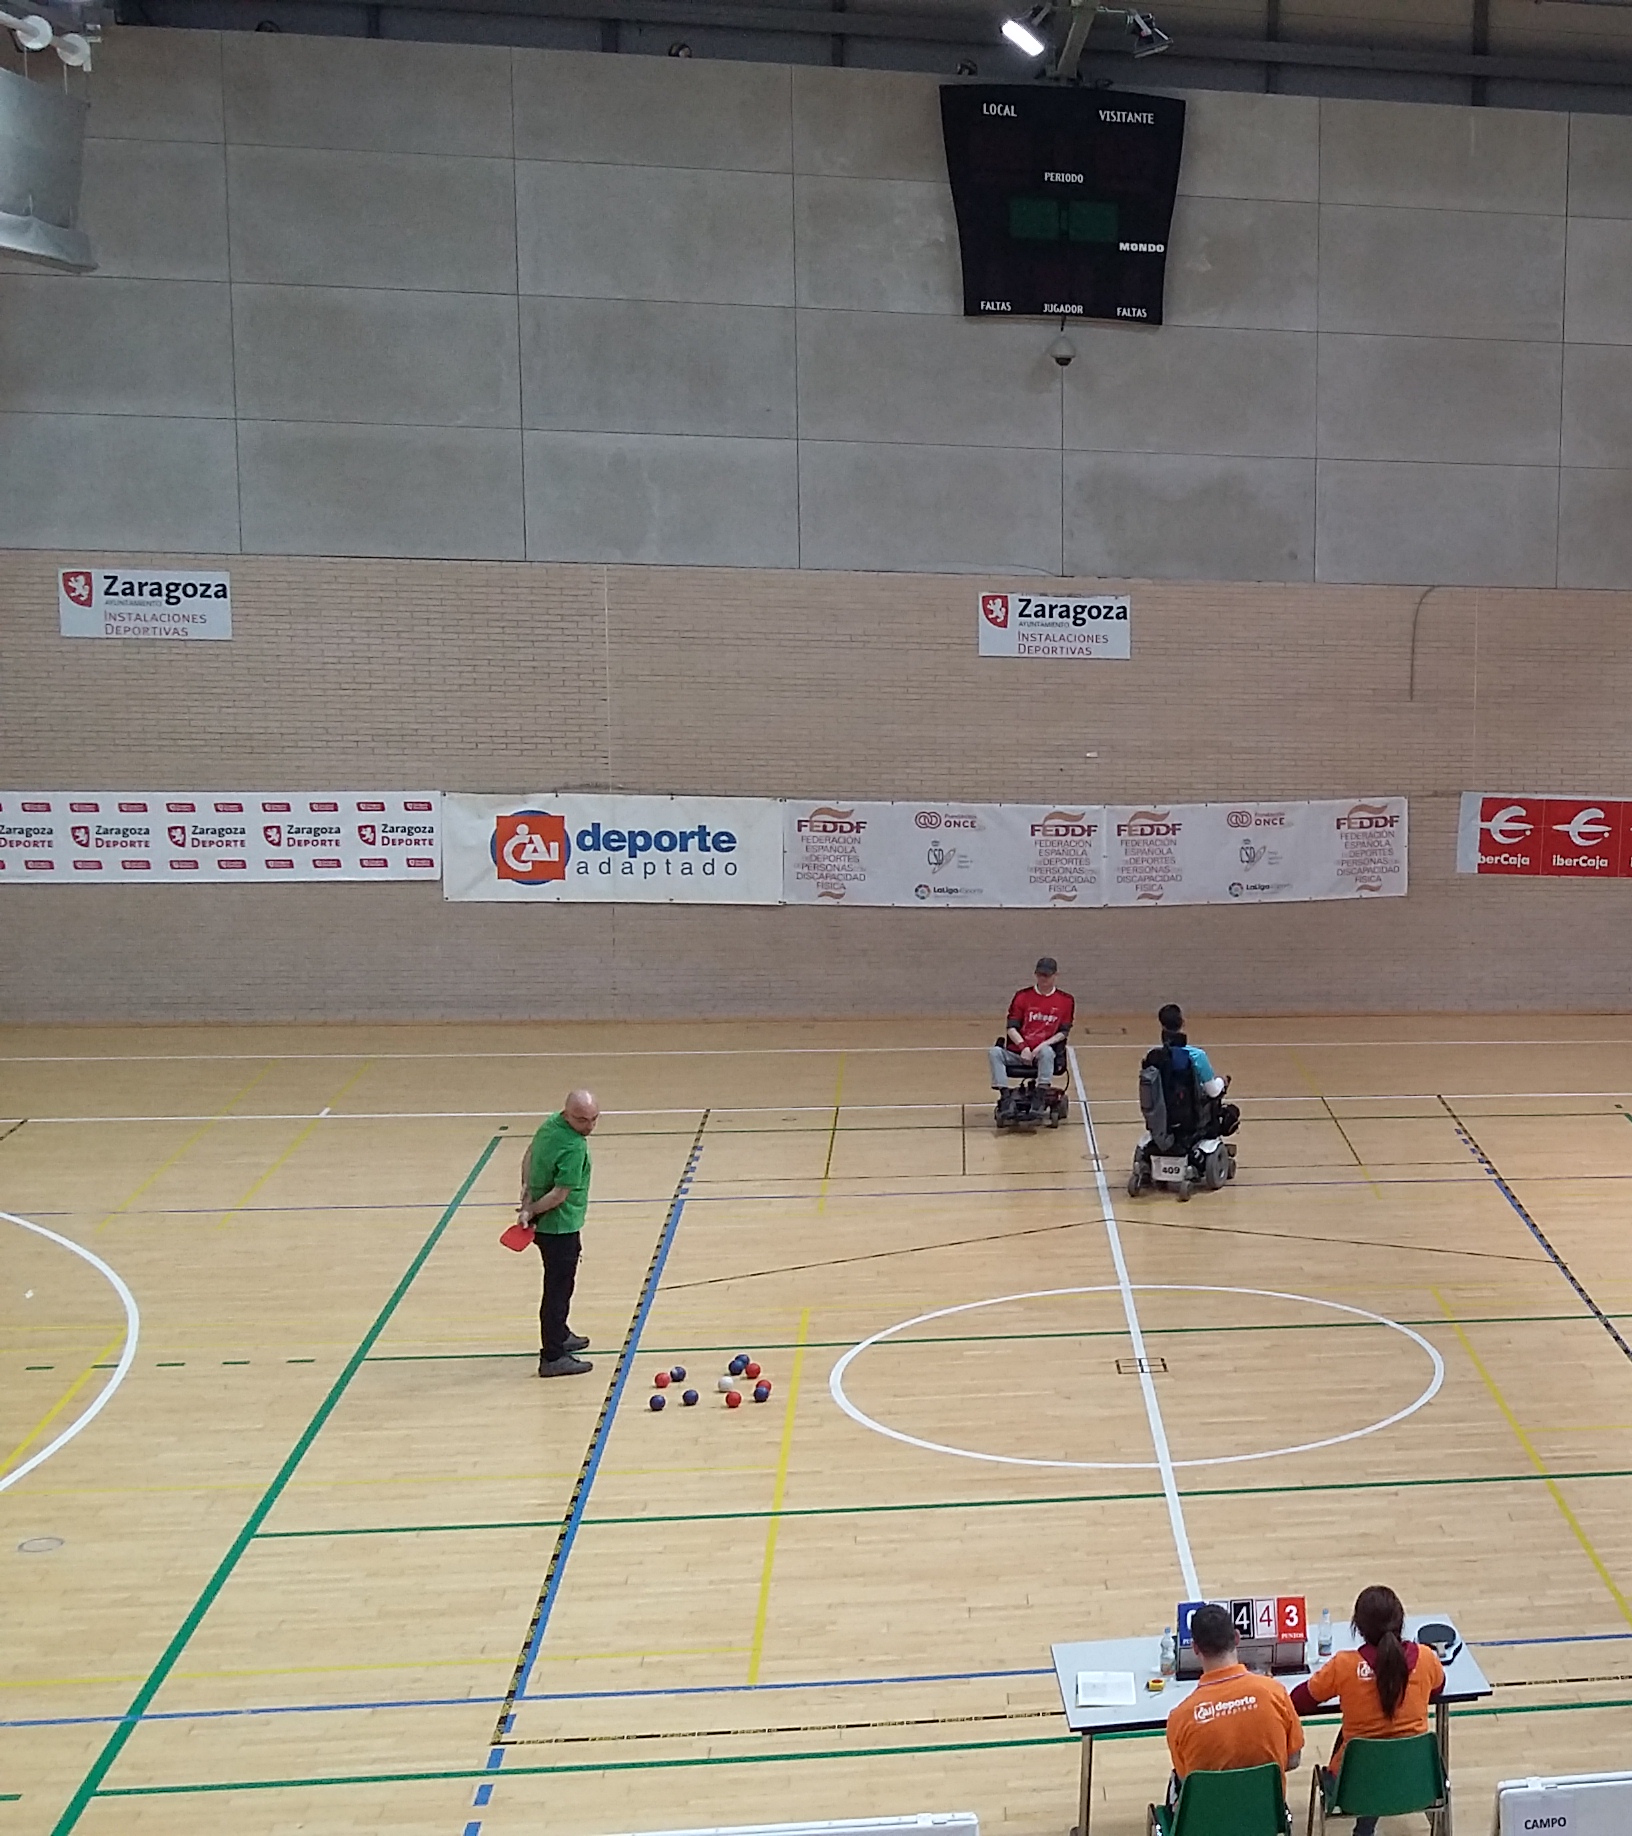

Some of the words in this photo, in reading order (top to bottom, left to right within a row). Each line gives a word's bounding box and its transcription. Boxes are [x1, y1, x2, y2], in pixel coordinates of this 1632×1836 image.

[983, 103, 1017, 117] LOCAL
[1099, 110, 1155, 125] VISITANTE
[1044, 172, 1084, 184] PERIODO
[1119, 242, 1165, 253] MONDO
[980, 300, 1011, 312] FALTAS
[1043, 303, 1083, 314] JUGADOR
[1116, 307, 1147, 318] FALTAS
[103, 575, 228, 606] Zaragoza
[104, 609, 207, 624] INSTALACIONES
[1018, 598, 1128, 627] Zaragoza
[105, 623, 189, 636] DEPORTIVAS
[1018, 631, 1109, 644] INSTALACIONES
[1018, 643, 1092, 656] DEPORTIVAS
[797, 819, 867, 834] FEDDF
[944, 820, 977, 828] ONCE
[1255, 817, 1285, 826] ONCE
[1336, 815, 1400, 830] FEDDF
[0, 825, 53, 837] Zaragoza
[95, 825, 150, 837] Zaragoza
[191, 825, 246, 837] Zaragoza
[287, 825, 341, 837] Zaragoza
[381, 824, 434, 836] Zaragoza
[1031, 824, 1098, 837] FEDDF
[1117, 823, 1183, 836] FEDDF
[0, 837, 53, 848] DEPORTE
[95, 837, 150, 848] DEPORTE
[191, 837, 246, 848] DEPORTE
[287, 837, 341, 847] DEPORTE
[381, 836, 434, 846] DEPORTE
[576, 823, 737, 858] deporte
[503, 823, 559, 873] CAI
[1478, 852, 1530, 867] berCaja
[1552, 854, 1608, 869] iberCaja
[576, 858, 738, 879] adaptado
[1162, 1166, 1180, 1174] 409
[1235, 1606, 1250, 1630] 4
[1259, 1605, 1273, 1628] 4
[1284, 1605, 1298, 1627] 3
[1215, 1695, 1256, 1711] deporte
[1524, 1817, 1567, 1830] CAMPO
